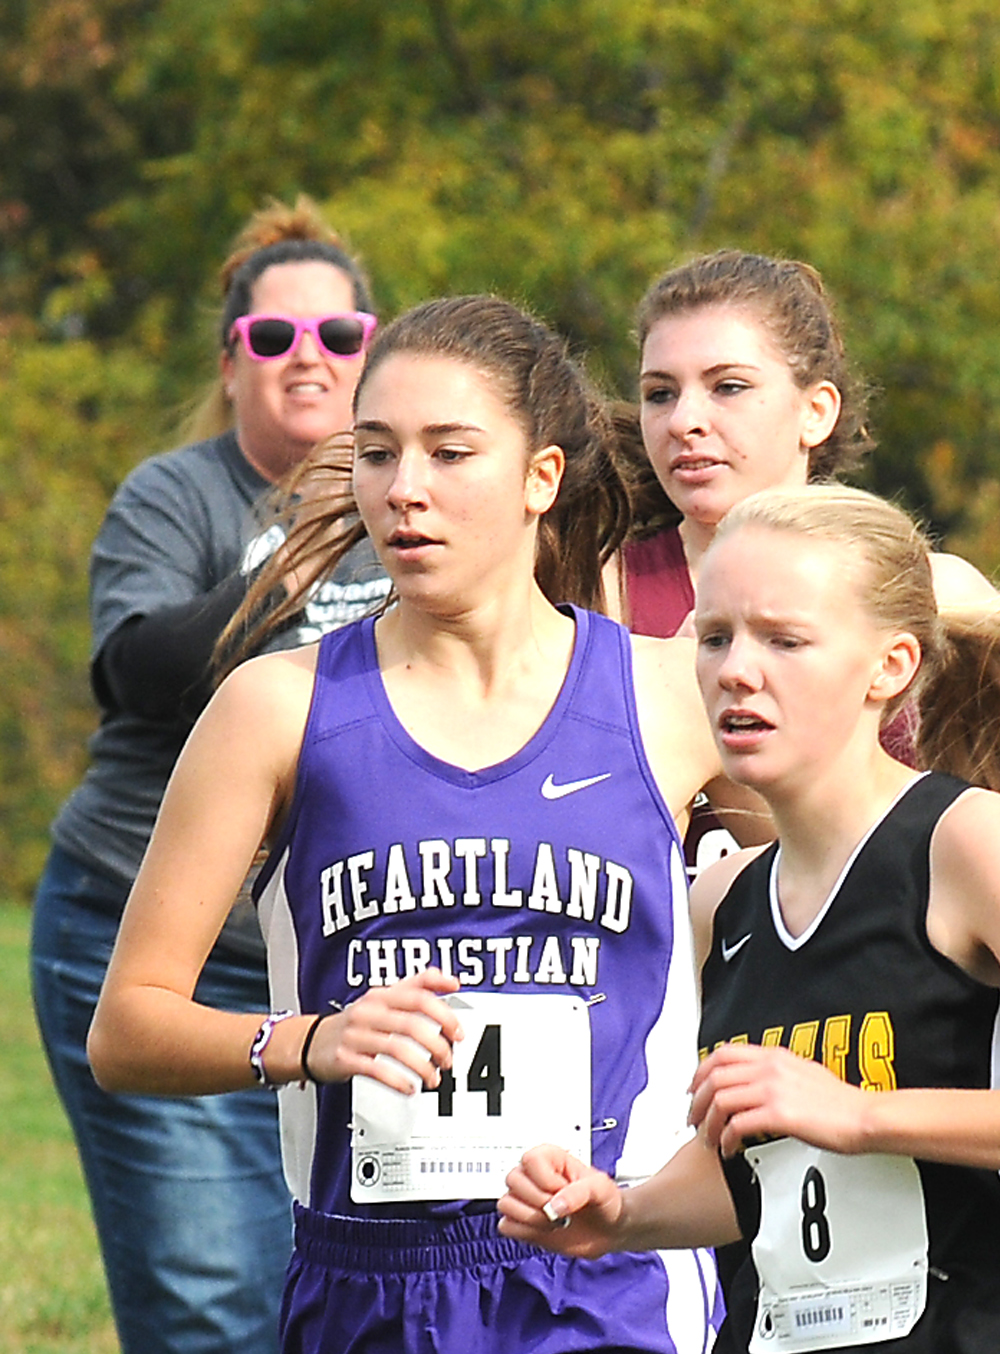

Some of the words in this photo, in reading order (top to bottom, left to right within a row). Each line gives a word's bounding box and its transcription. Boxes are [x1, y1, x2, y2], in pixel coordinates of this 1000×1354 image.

[320, 838, 635, 937] HEARTLAND
[346, 936, 600, 987] CHRISTIAN
[801, 1165, 831, 1263] 8
